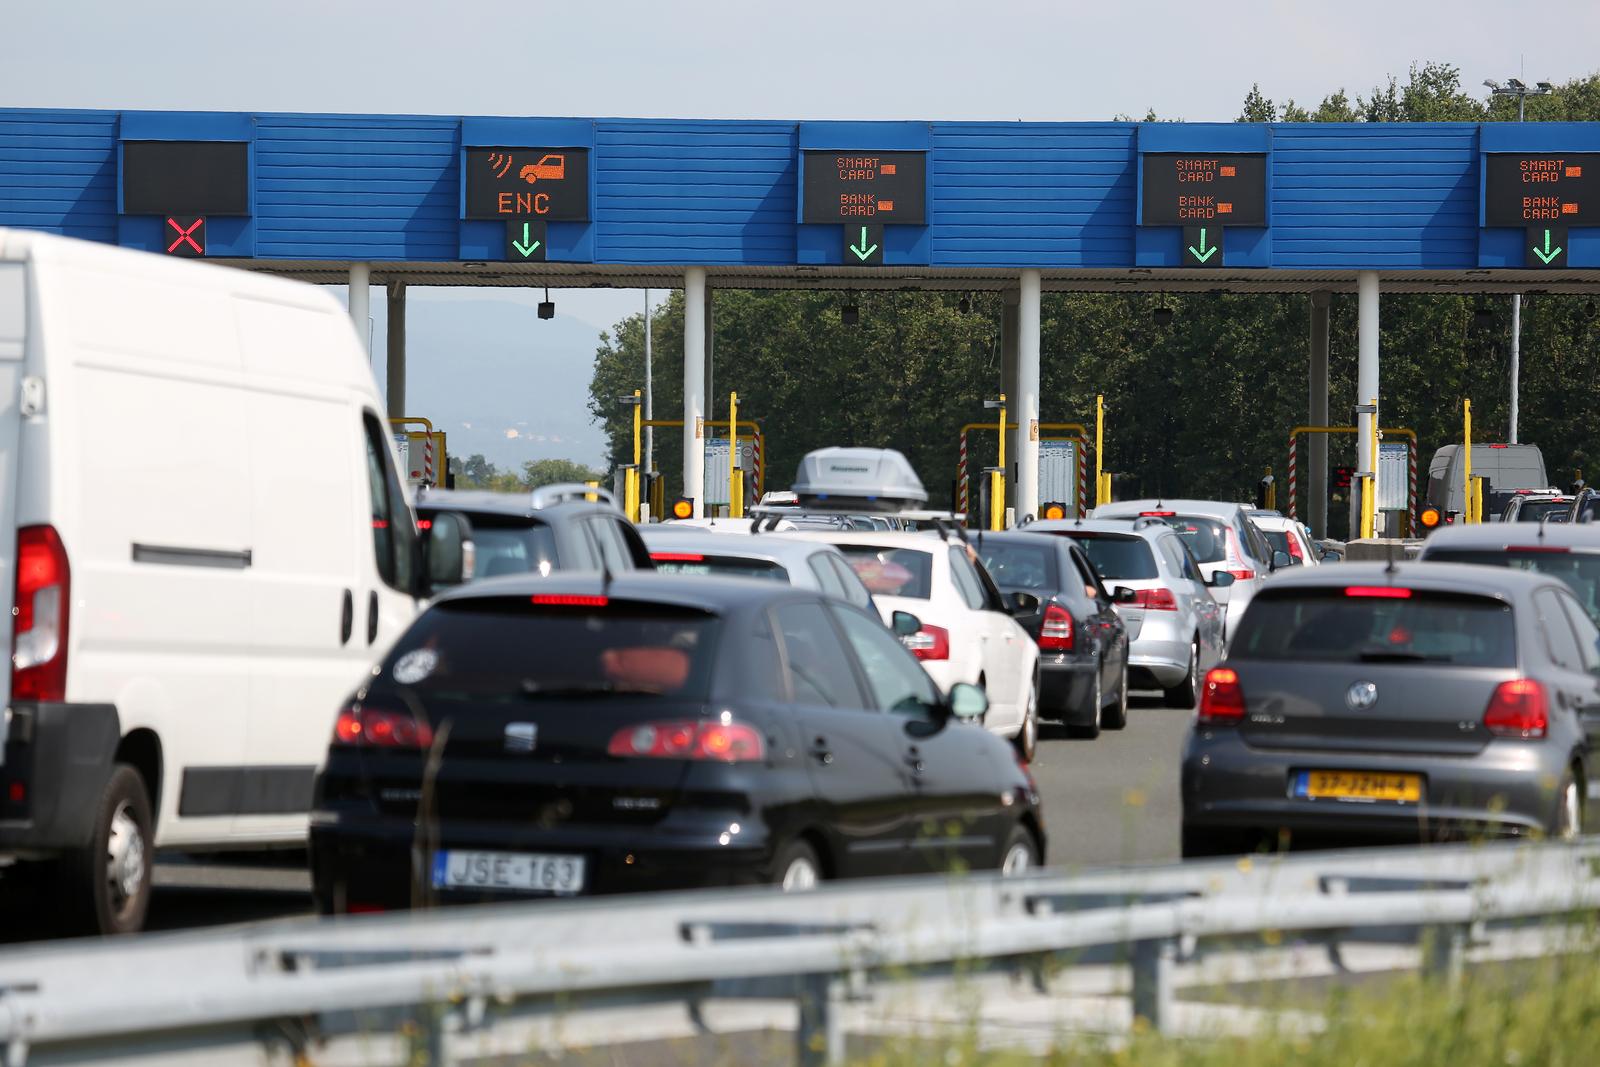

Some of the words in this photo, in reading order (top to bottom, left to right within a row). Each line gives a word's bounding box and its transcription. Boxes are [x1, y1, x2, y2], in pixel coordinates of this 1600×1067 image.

[837, 158, 879, 168] SMART
[1176, 160, 1218, 170] SMART
[1520, 160, 1564, 171] SMART
[840, 169, 874, 180] CARD
[1179, 171, 1213, 182] CARD
[1522, 172, 1558, 182] CARD
[498, 192, 550, 214] ENC
[840, 193, 875, 204] BANK
[1179, 196, 1214, 207] BANK
[1523, 197, 1559, 207] BANK
[840, 205, 875, 216] CARD
[1179, 208, 1214, 218] CARD
[1523, 208, 1559, 219] CARD
[452, 856, 577, 888] JSE-163
